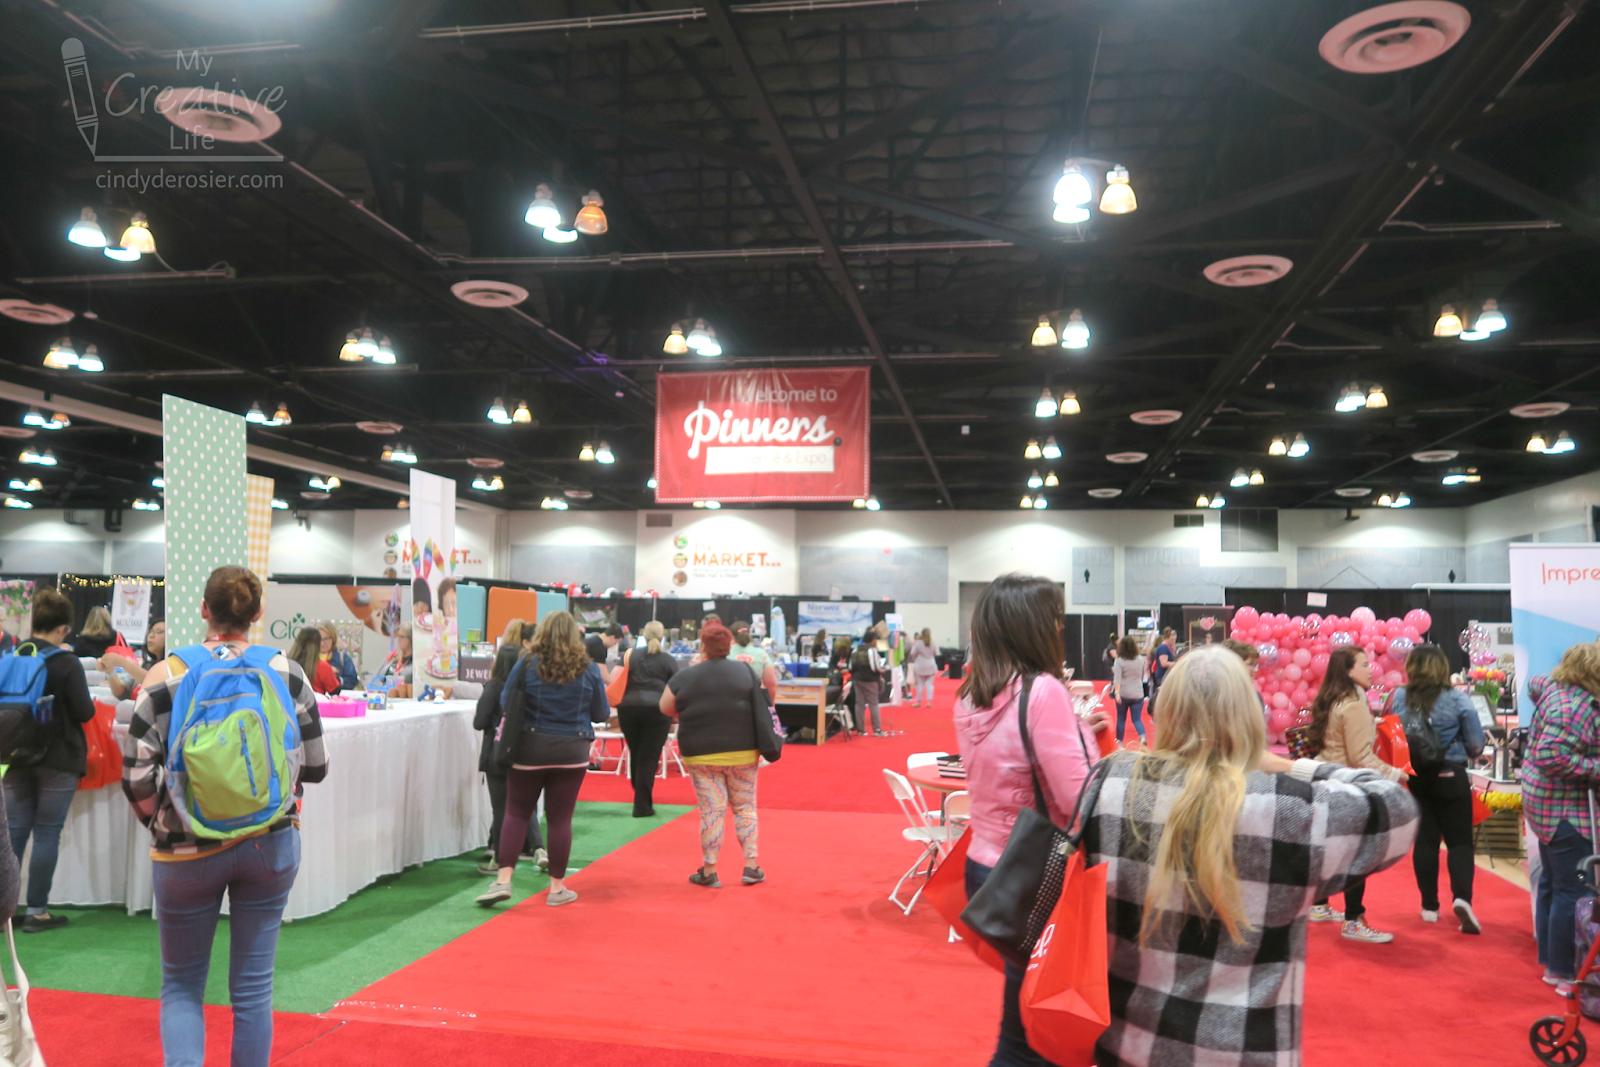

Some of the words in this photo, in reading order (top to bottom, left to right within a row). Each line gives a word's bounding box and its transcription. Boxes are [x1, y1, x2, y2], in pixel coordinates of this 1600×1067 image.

[739, 387, 816, 403] Welcome
[819, 387, 838, 402] to
[684, 400, 835, 459] Pinners
[796, 451, 828, 466] Expo
